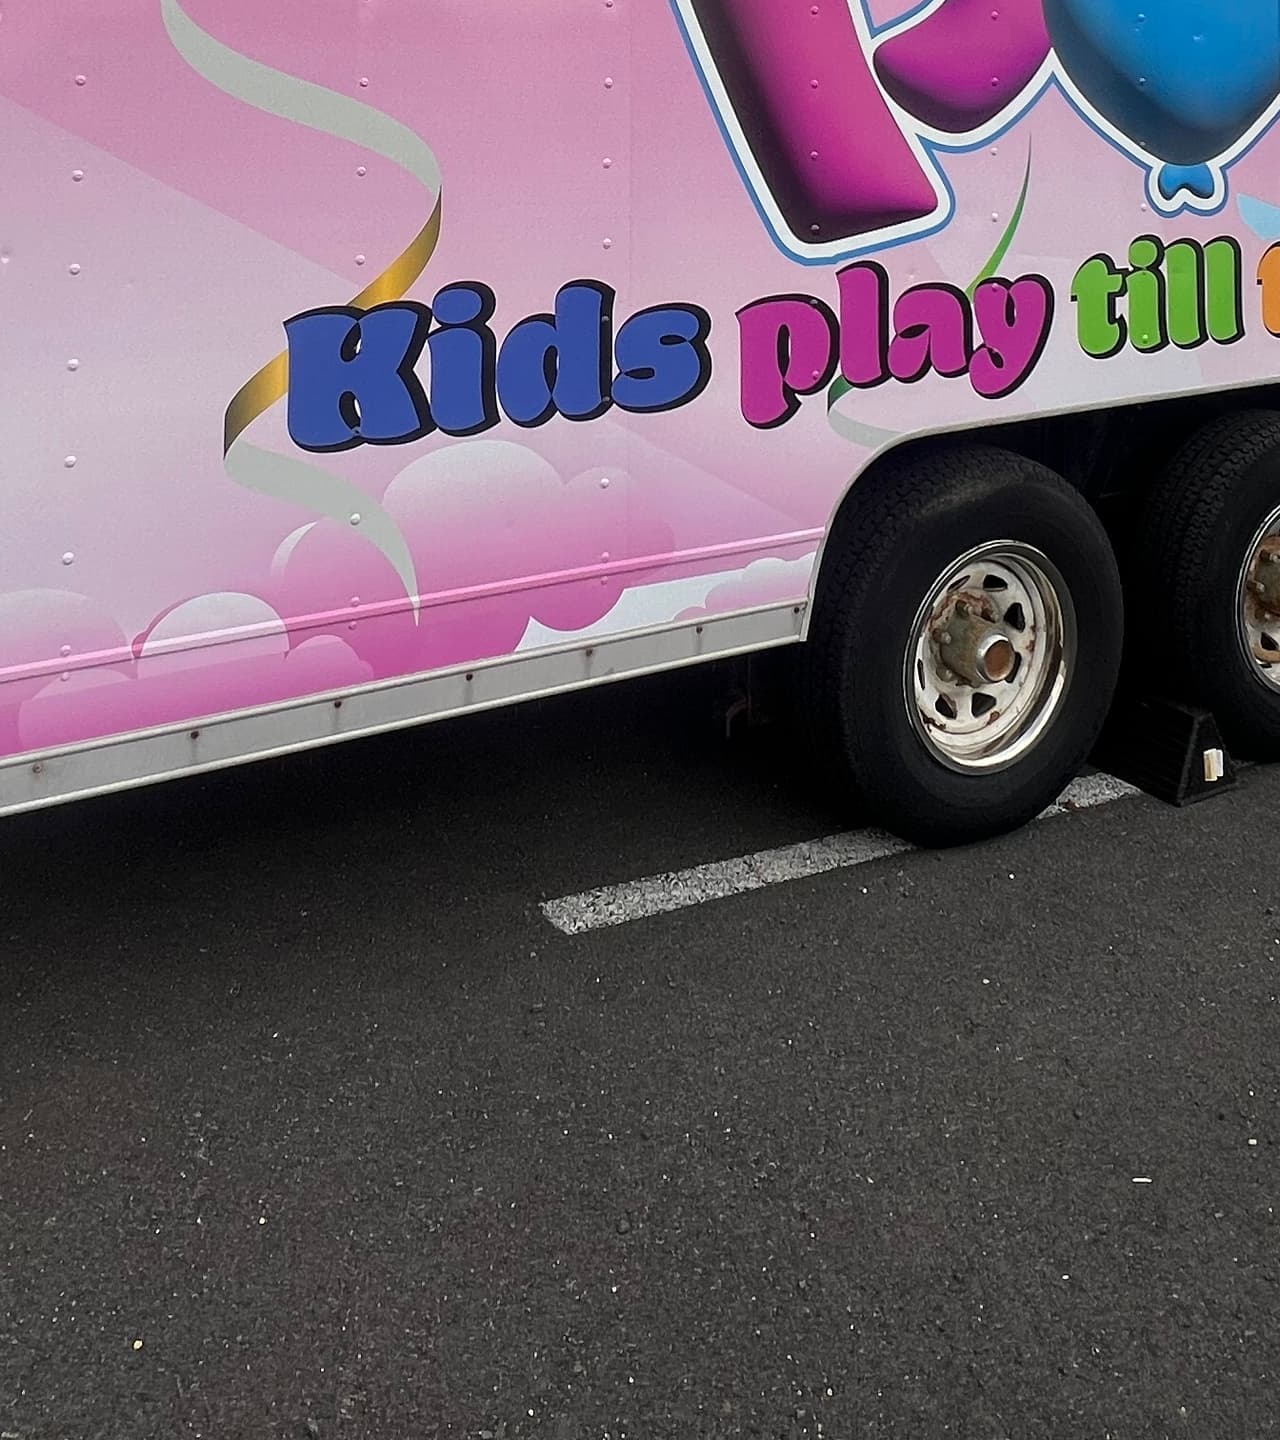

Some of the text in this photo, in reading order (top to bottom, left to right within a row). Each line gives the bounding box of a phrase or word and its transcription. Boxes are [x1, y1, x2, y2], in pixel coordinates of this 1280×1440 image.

[284, 280, 712, 452] Kids
[736, 261, 1055, 429] play
[1070, 234, 1245, 359] till
